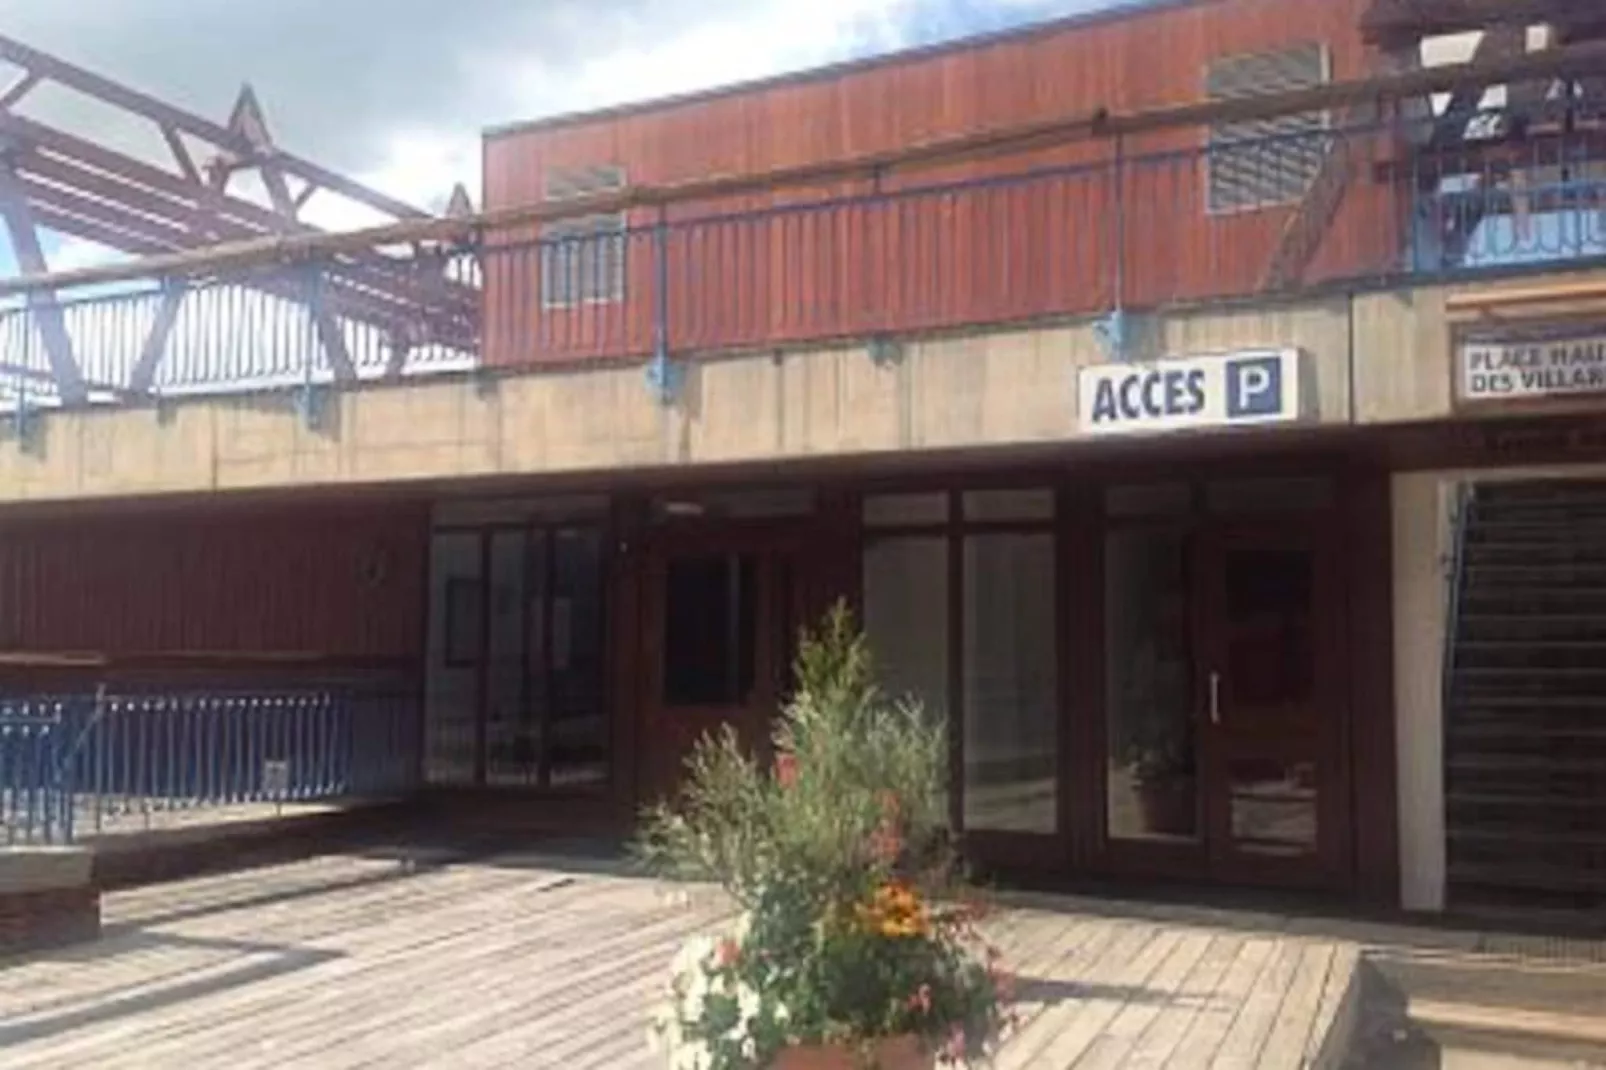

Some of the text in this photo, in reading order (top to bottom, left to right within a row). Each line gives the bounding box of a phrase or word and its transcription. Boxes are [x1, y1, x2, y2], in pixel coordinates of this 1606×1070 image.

[1470, 348, 1541, 371] PLACE
[1092, 365, 1270, 422] ACCES P
[1471, 373, 1513, 393] DES
